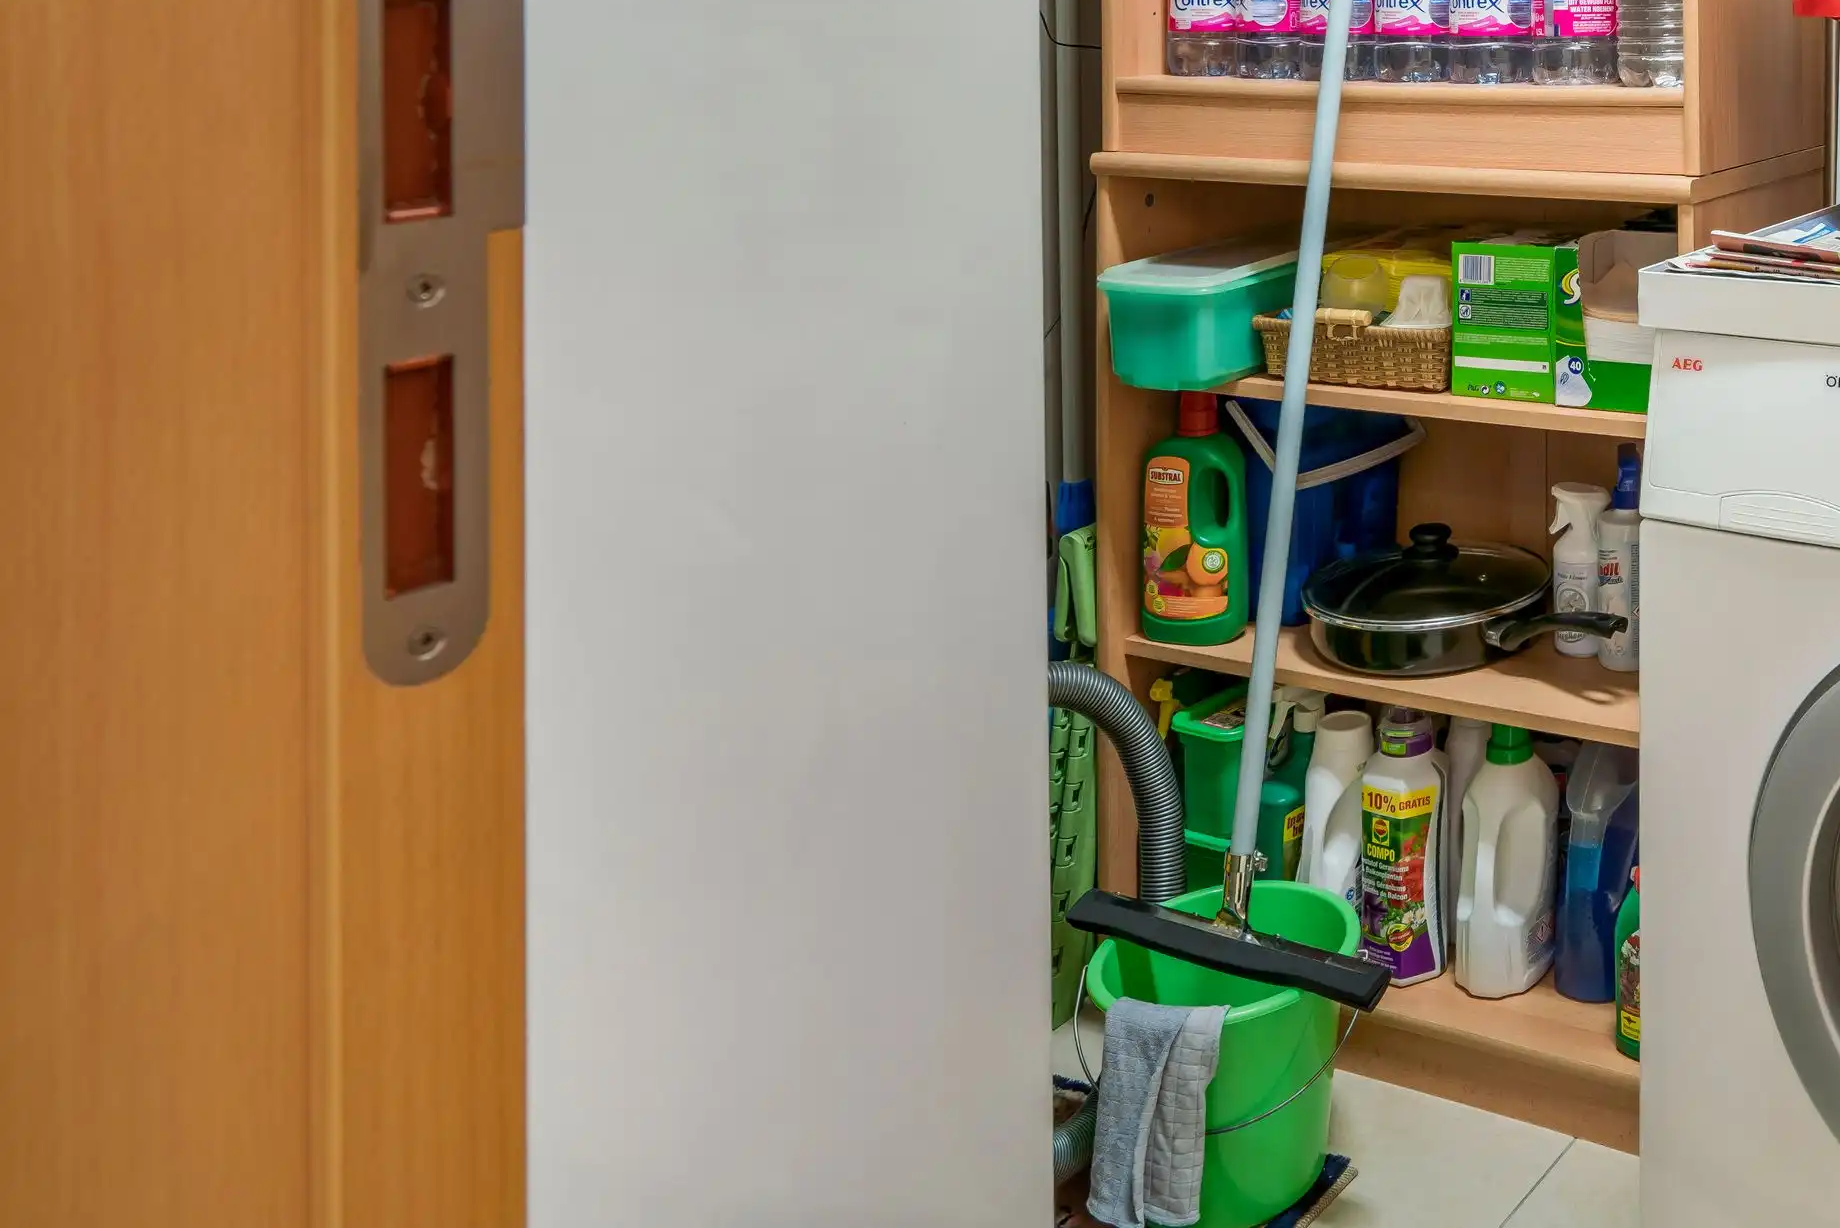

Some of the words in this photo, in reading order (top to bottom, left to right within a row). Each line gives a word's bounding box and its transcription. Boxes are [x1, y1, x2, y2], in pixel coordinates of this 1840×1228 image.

[1570, 5, 1592, 13] WATER
[1570, 360, 1581, 371] 40
[1671, 357, 1703, 372] AEG
[1150, 470, 1182, 482] SUBSTRAL
[1367, 791, 1396, 813] 10%
[1399, 795, 1431, 811] GRATIS
[1367, 843, 1396, 862] COMPO
